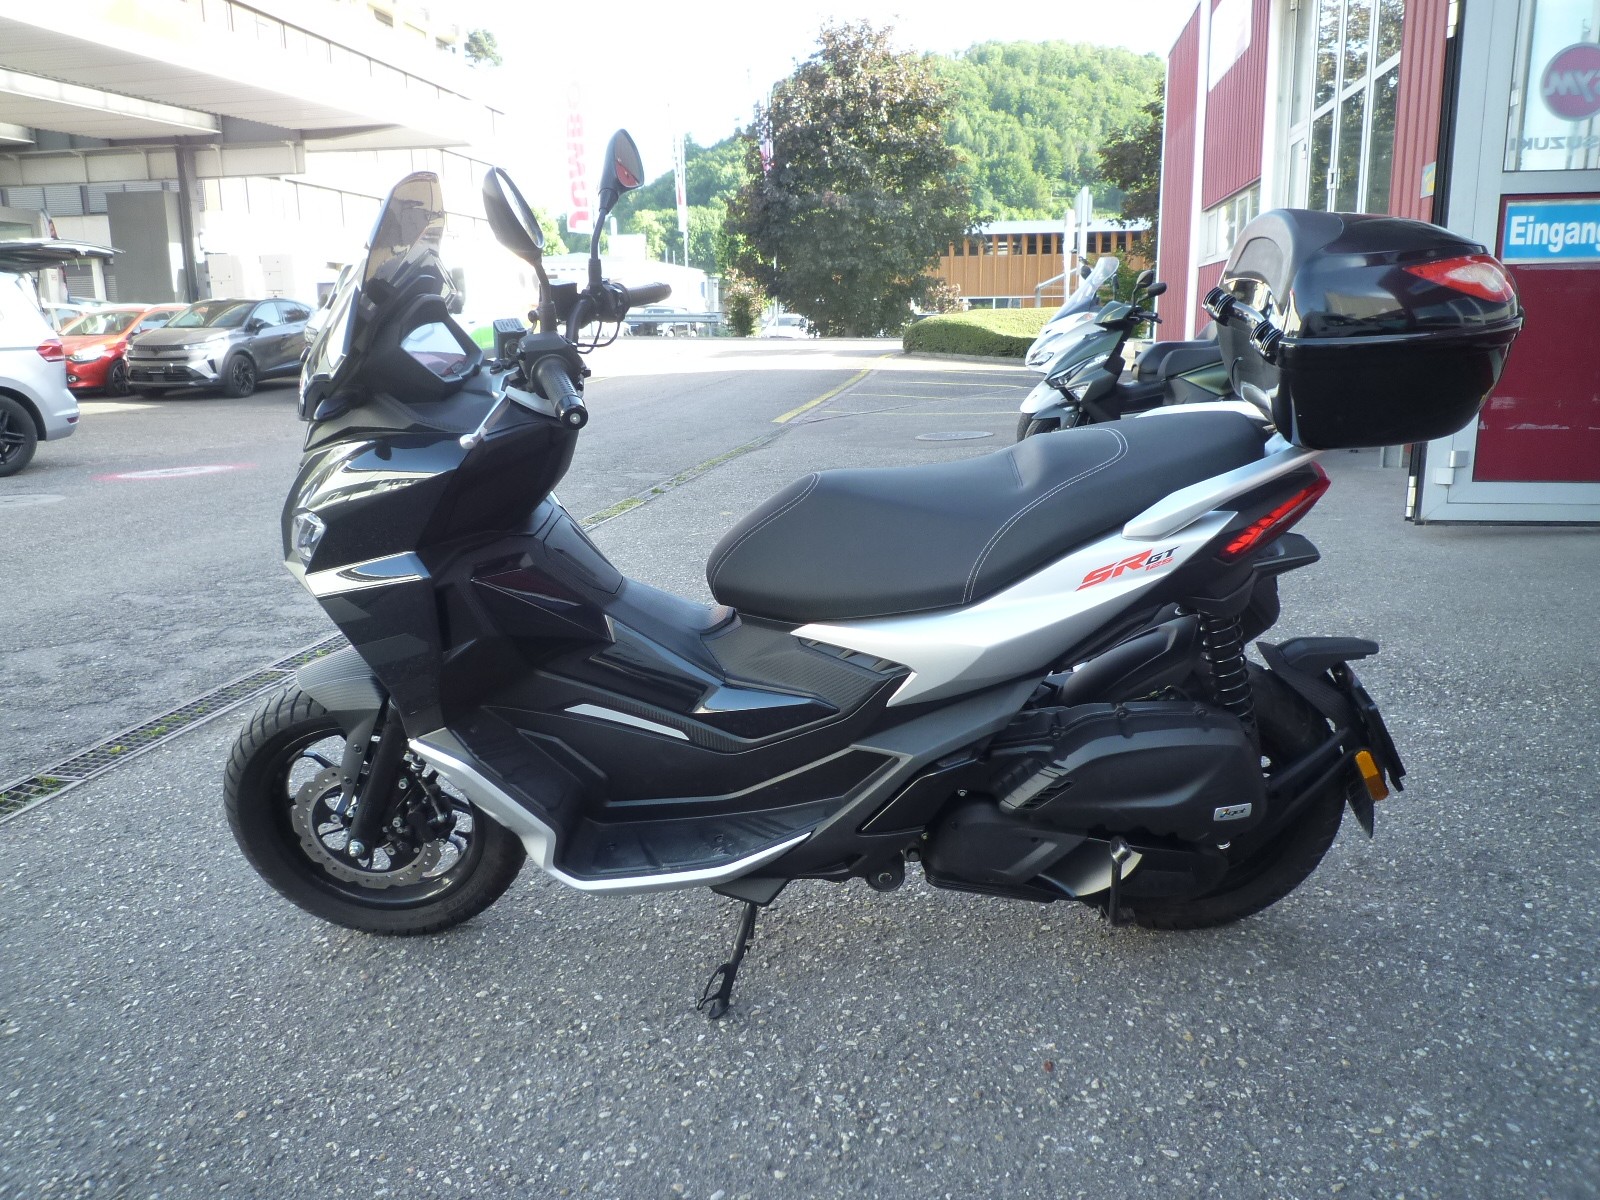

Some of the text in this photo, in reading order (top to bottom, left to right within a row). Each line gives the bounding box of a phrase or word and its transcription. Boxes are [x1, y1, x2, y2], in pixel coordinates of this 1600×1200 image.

[1509, 215, 1600, 253] Eingan
[1075, 545, 1180, 592] SR GT
